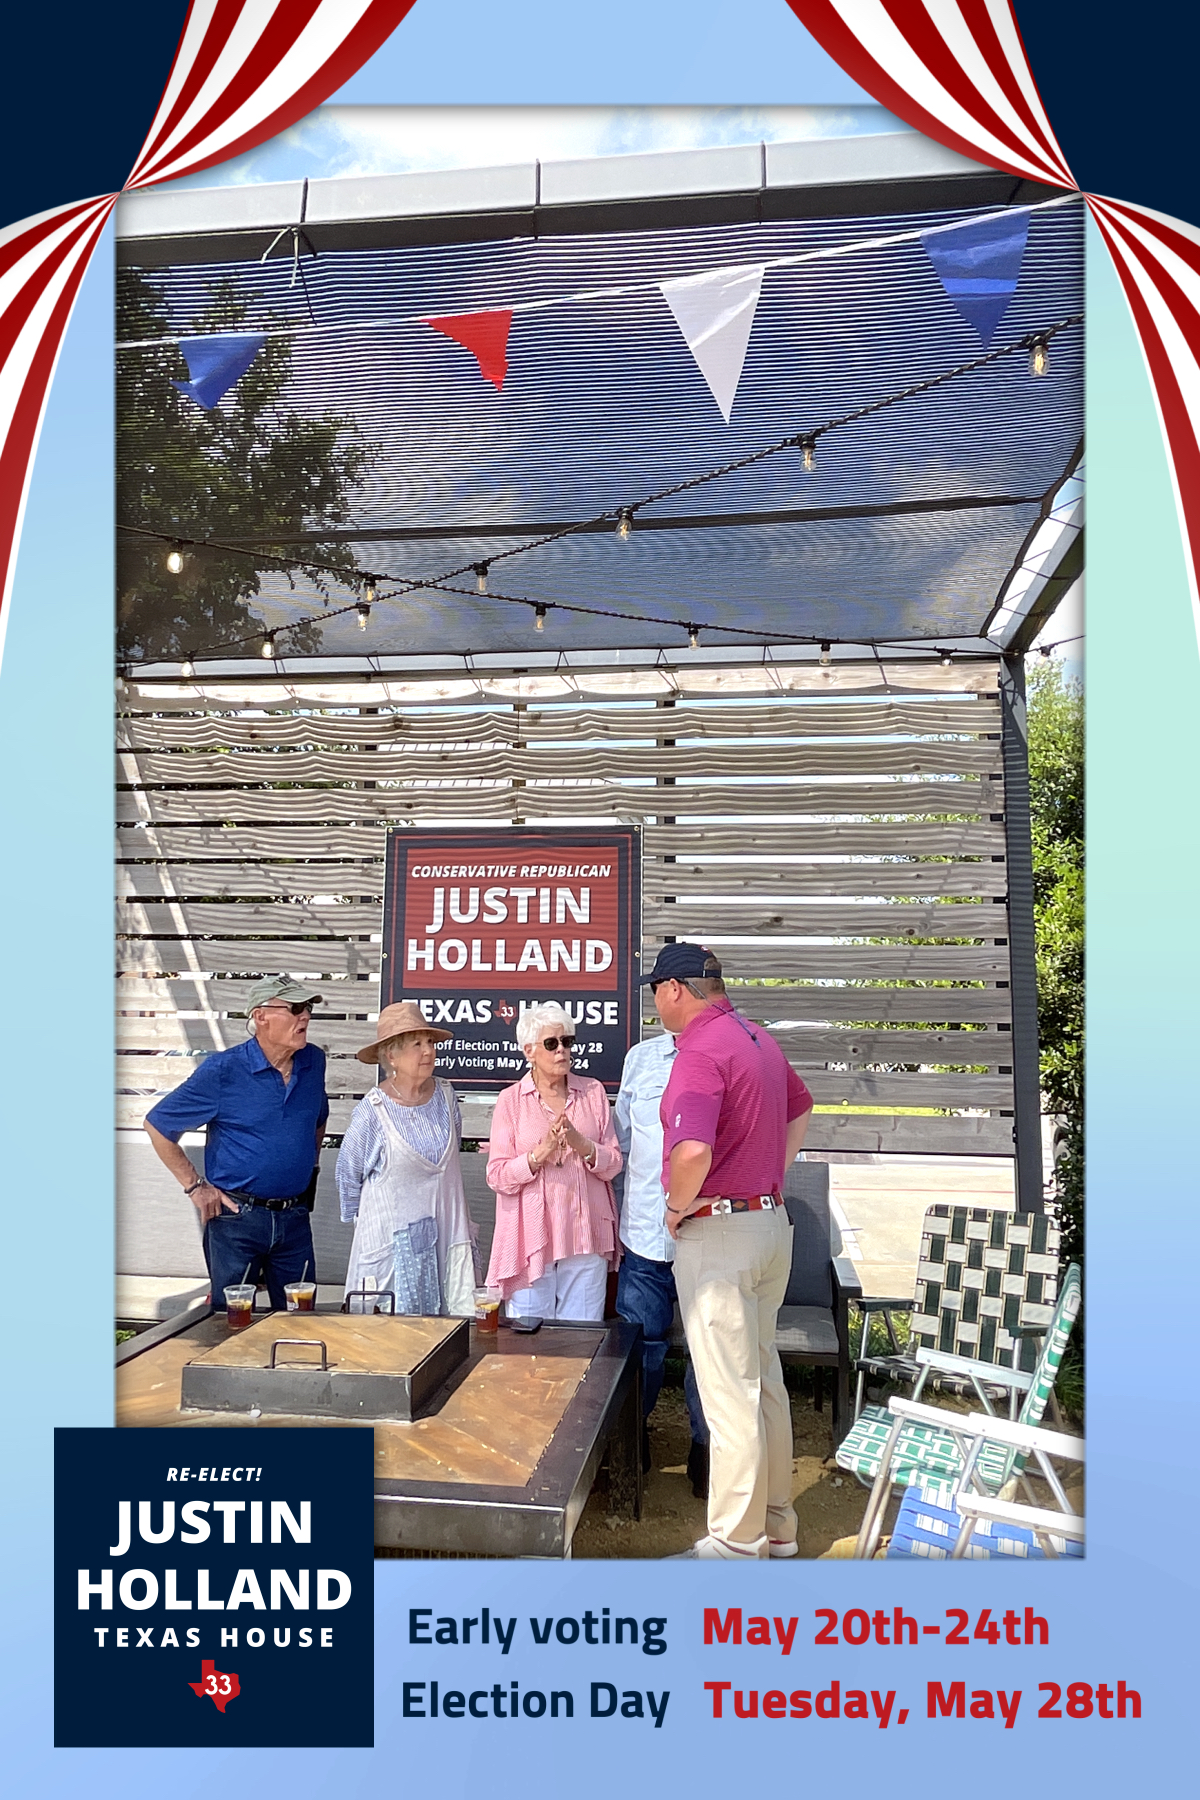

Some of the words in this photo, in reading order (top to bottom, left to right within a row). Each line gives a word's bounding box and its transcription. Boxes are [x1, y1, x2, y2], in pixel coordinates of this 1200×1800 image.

[411, 865, 516, 878] CONSERVATIVE
[520, 865, 611, 878] REPUBLICAN
[425, 886, 591, 934] JUSTIN
[406, 938, 613, 973] HOLLAND
[402, 999, 492, 1023] EXAS
[500, 1006, 514, 1017] 33
[455, 1040, 500, 1051] Election
[571, 1045, 586, 1055] ay
[588, 1042, 603, 1053] 28
[434, 1056, 456, 1069] arly
[457, 1057, 495, 1070] Voting
[497, 1057, 523, 1070] May
[574, 1059, 589, 1069] 24
